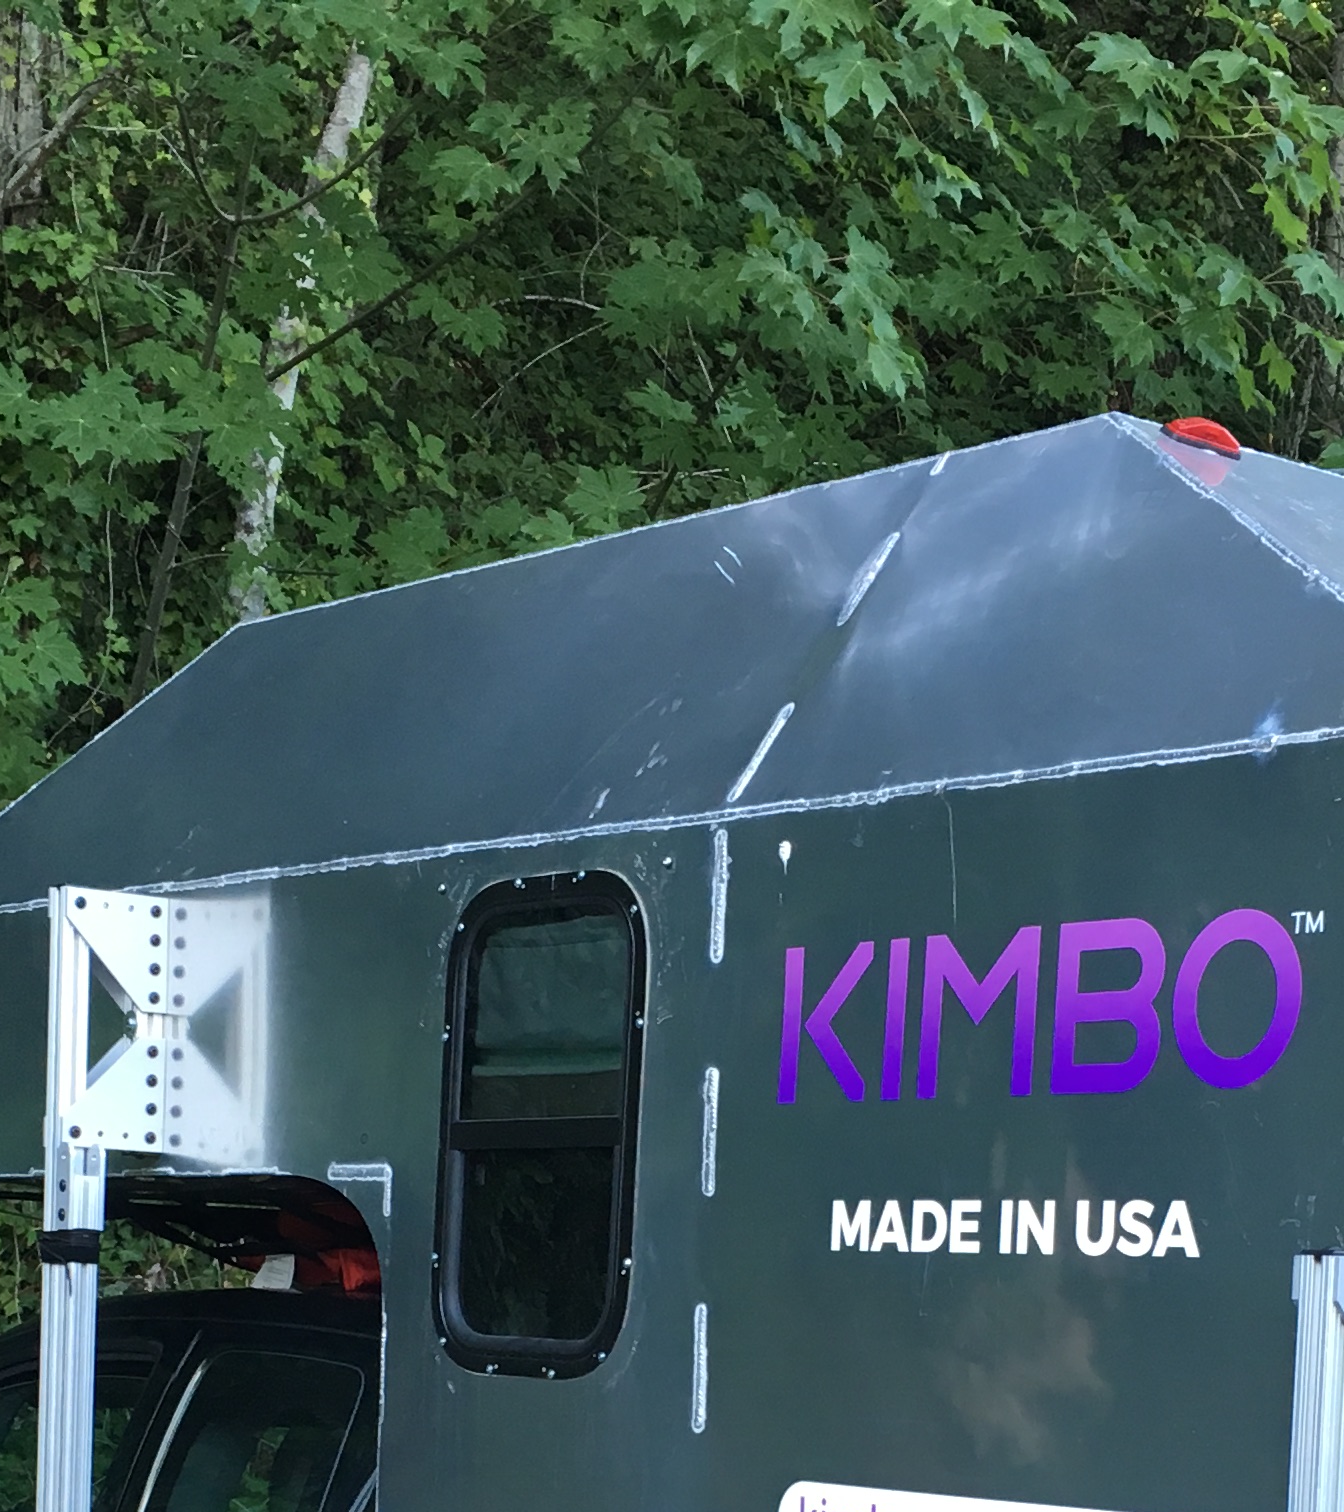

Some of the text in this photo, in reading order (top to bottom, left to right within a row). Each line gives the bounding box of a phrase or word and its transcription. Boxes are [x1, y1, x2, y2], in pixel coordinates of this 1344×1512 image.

[777, 908, 1303, 1104] KIMBO
[830, 1199, 1201, 1258] MADE IN USA
